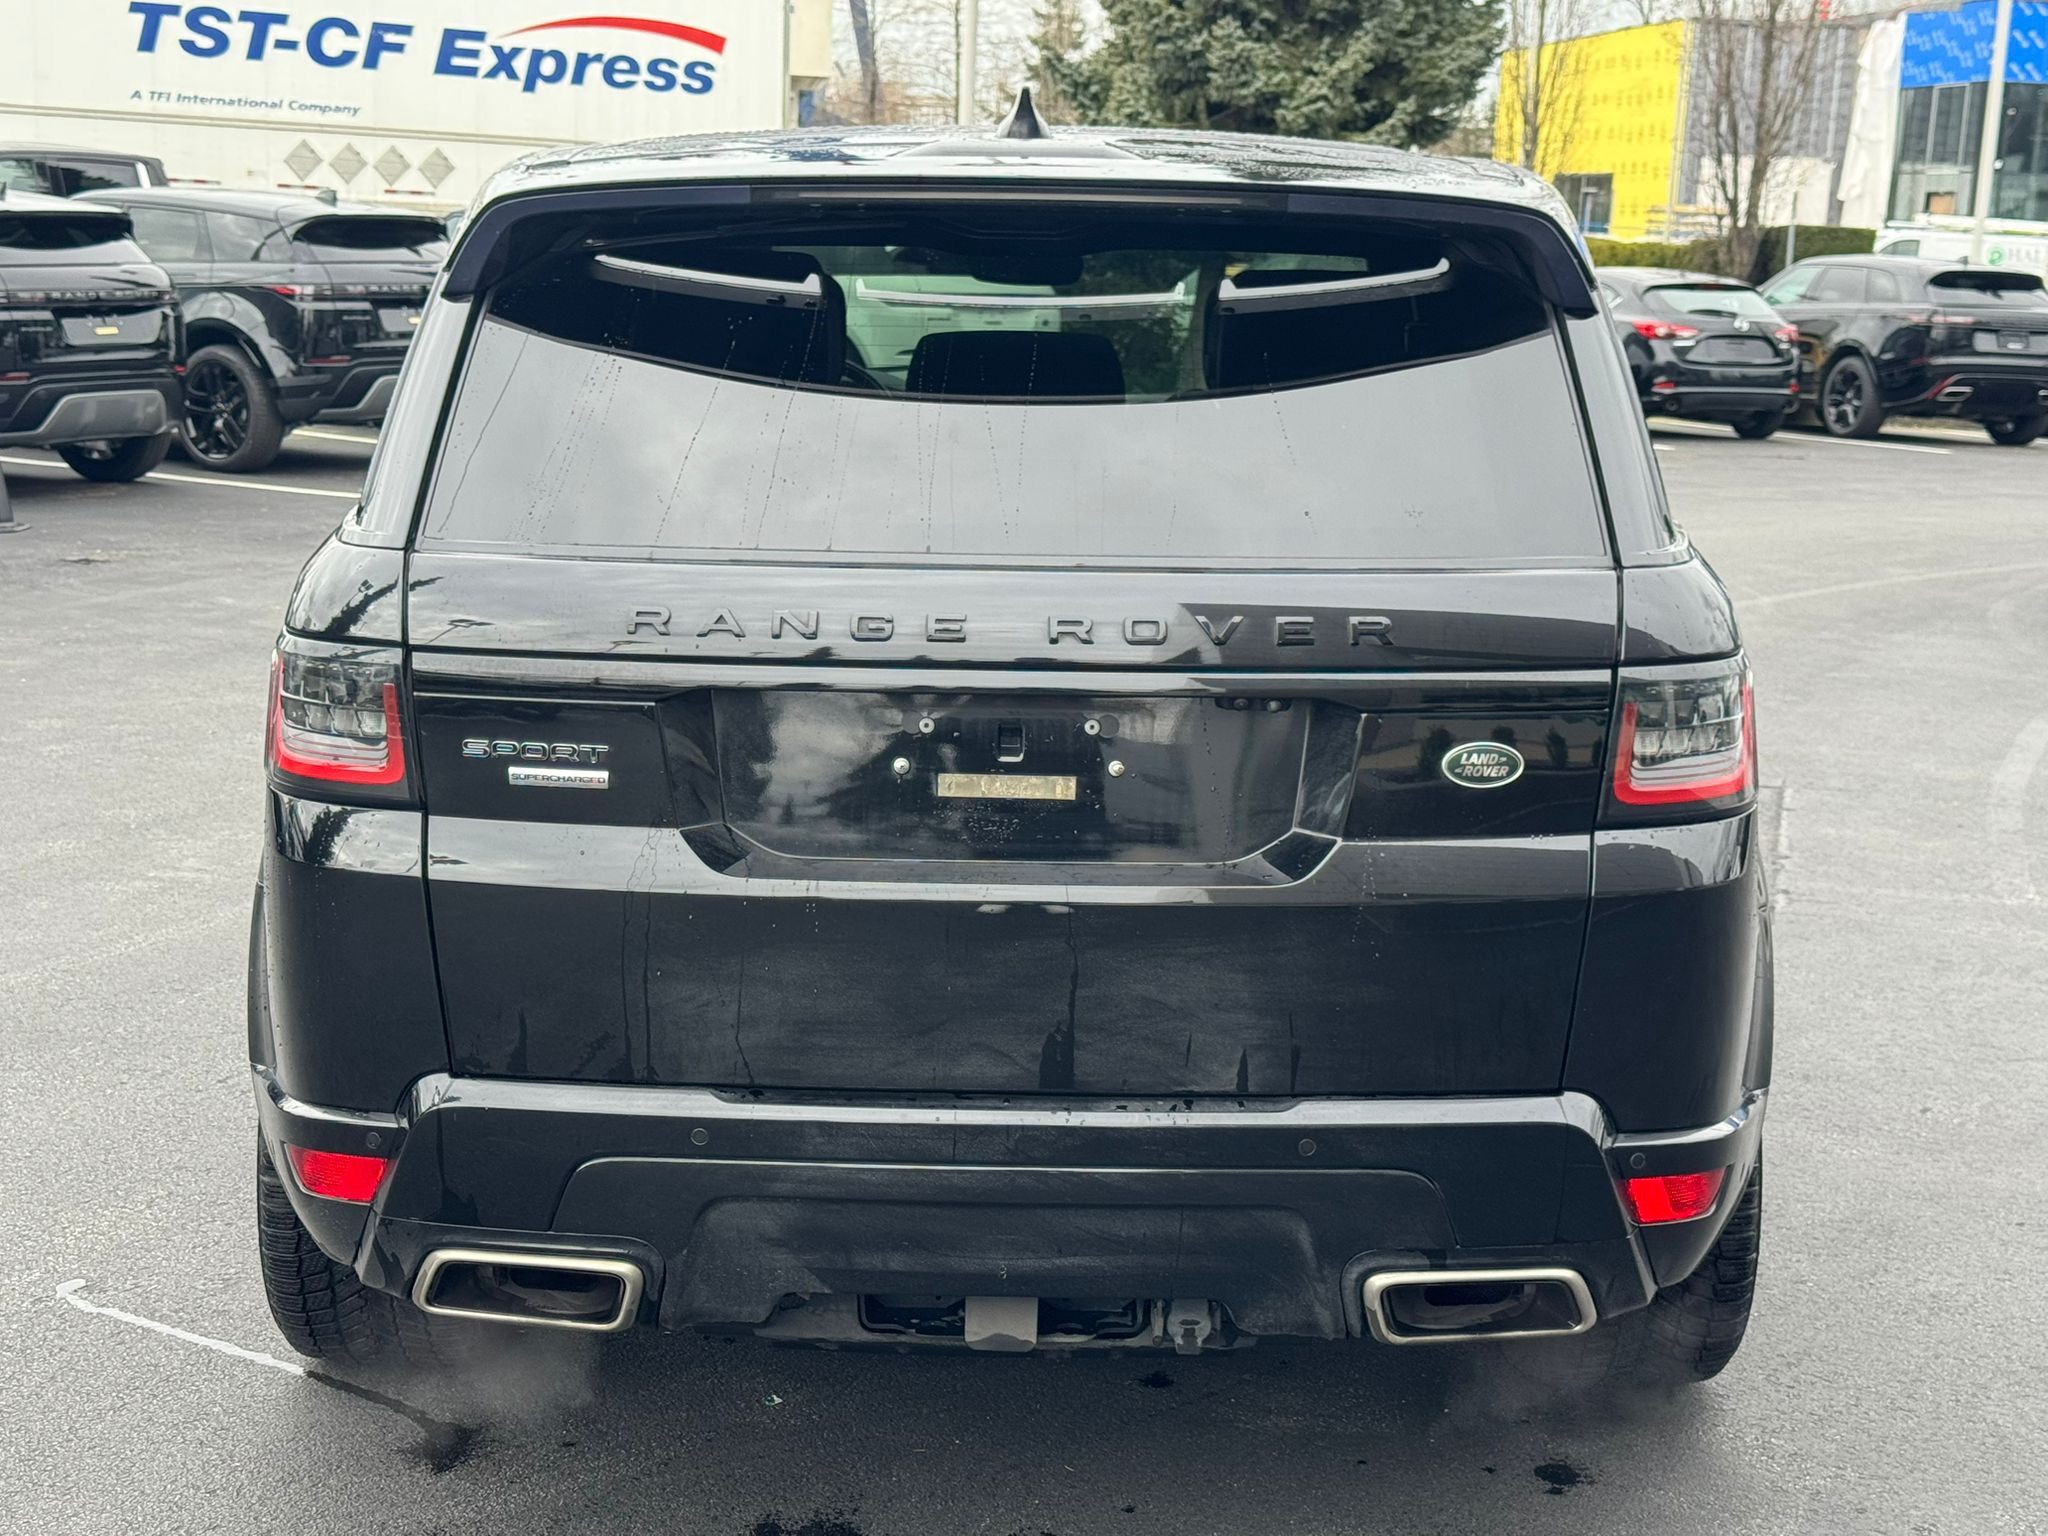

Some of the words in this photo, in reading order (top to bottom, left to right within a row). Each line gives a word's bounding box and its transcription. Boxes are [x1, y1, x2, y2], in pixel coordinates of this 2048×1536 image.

[130, 1, 414, 70] TST-CF
[433, 28, 715, 95] Express
[130, 90, 143, 100] A
[149, 91, 171, 103] TFI
[176, 93, 284, 110] International
[288, 100, 362, 116] Company
[626, 606, 967, 642] RANGE
[1048, 615, 1396, 646] ROVER
[461, 738, 610, 764] SPORT
[1460, 752, 1499, 765] LAND
[510, 773, 606, 784] SUPERCHARGED
[1462, 765, 1509, 777] ROVER
